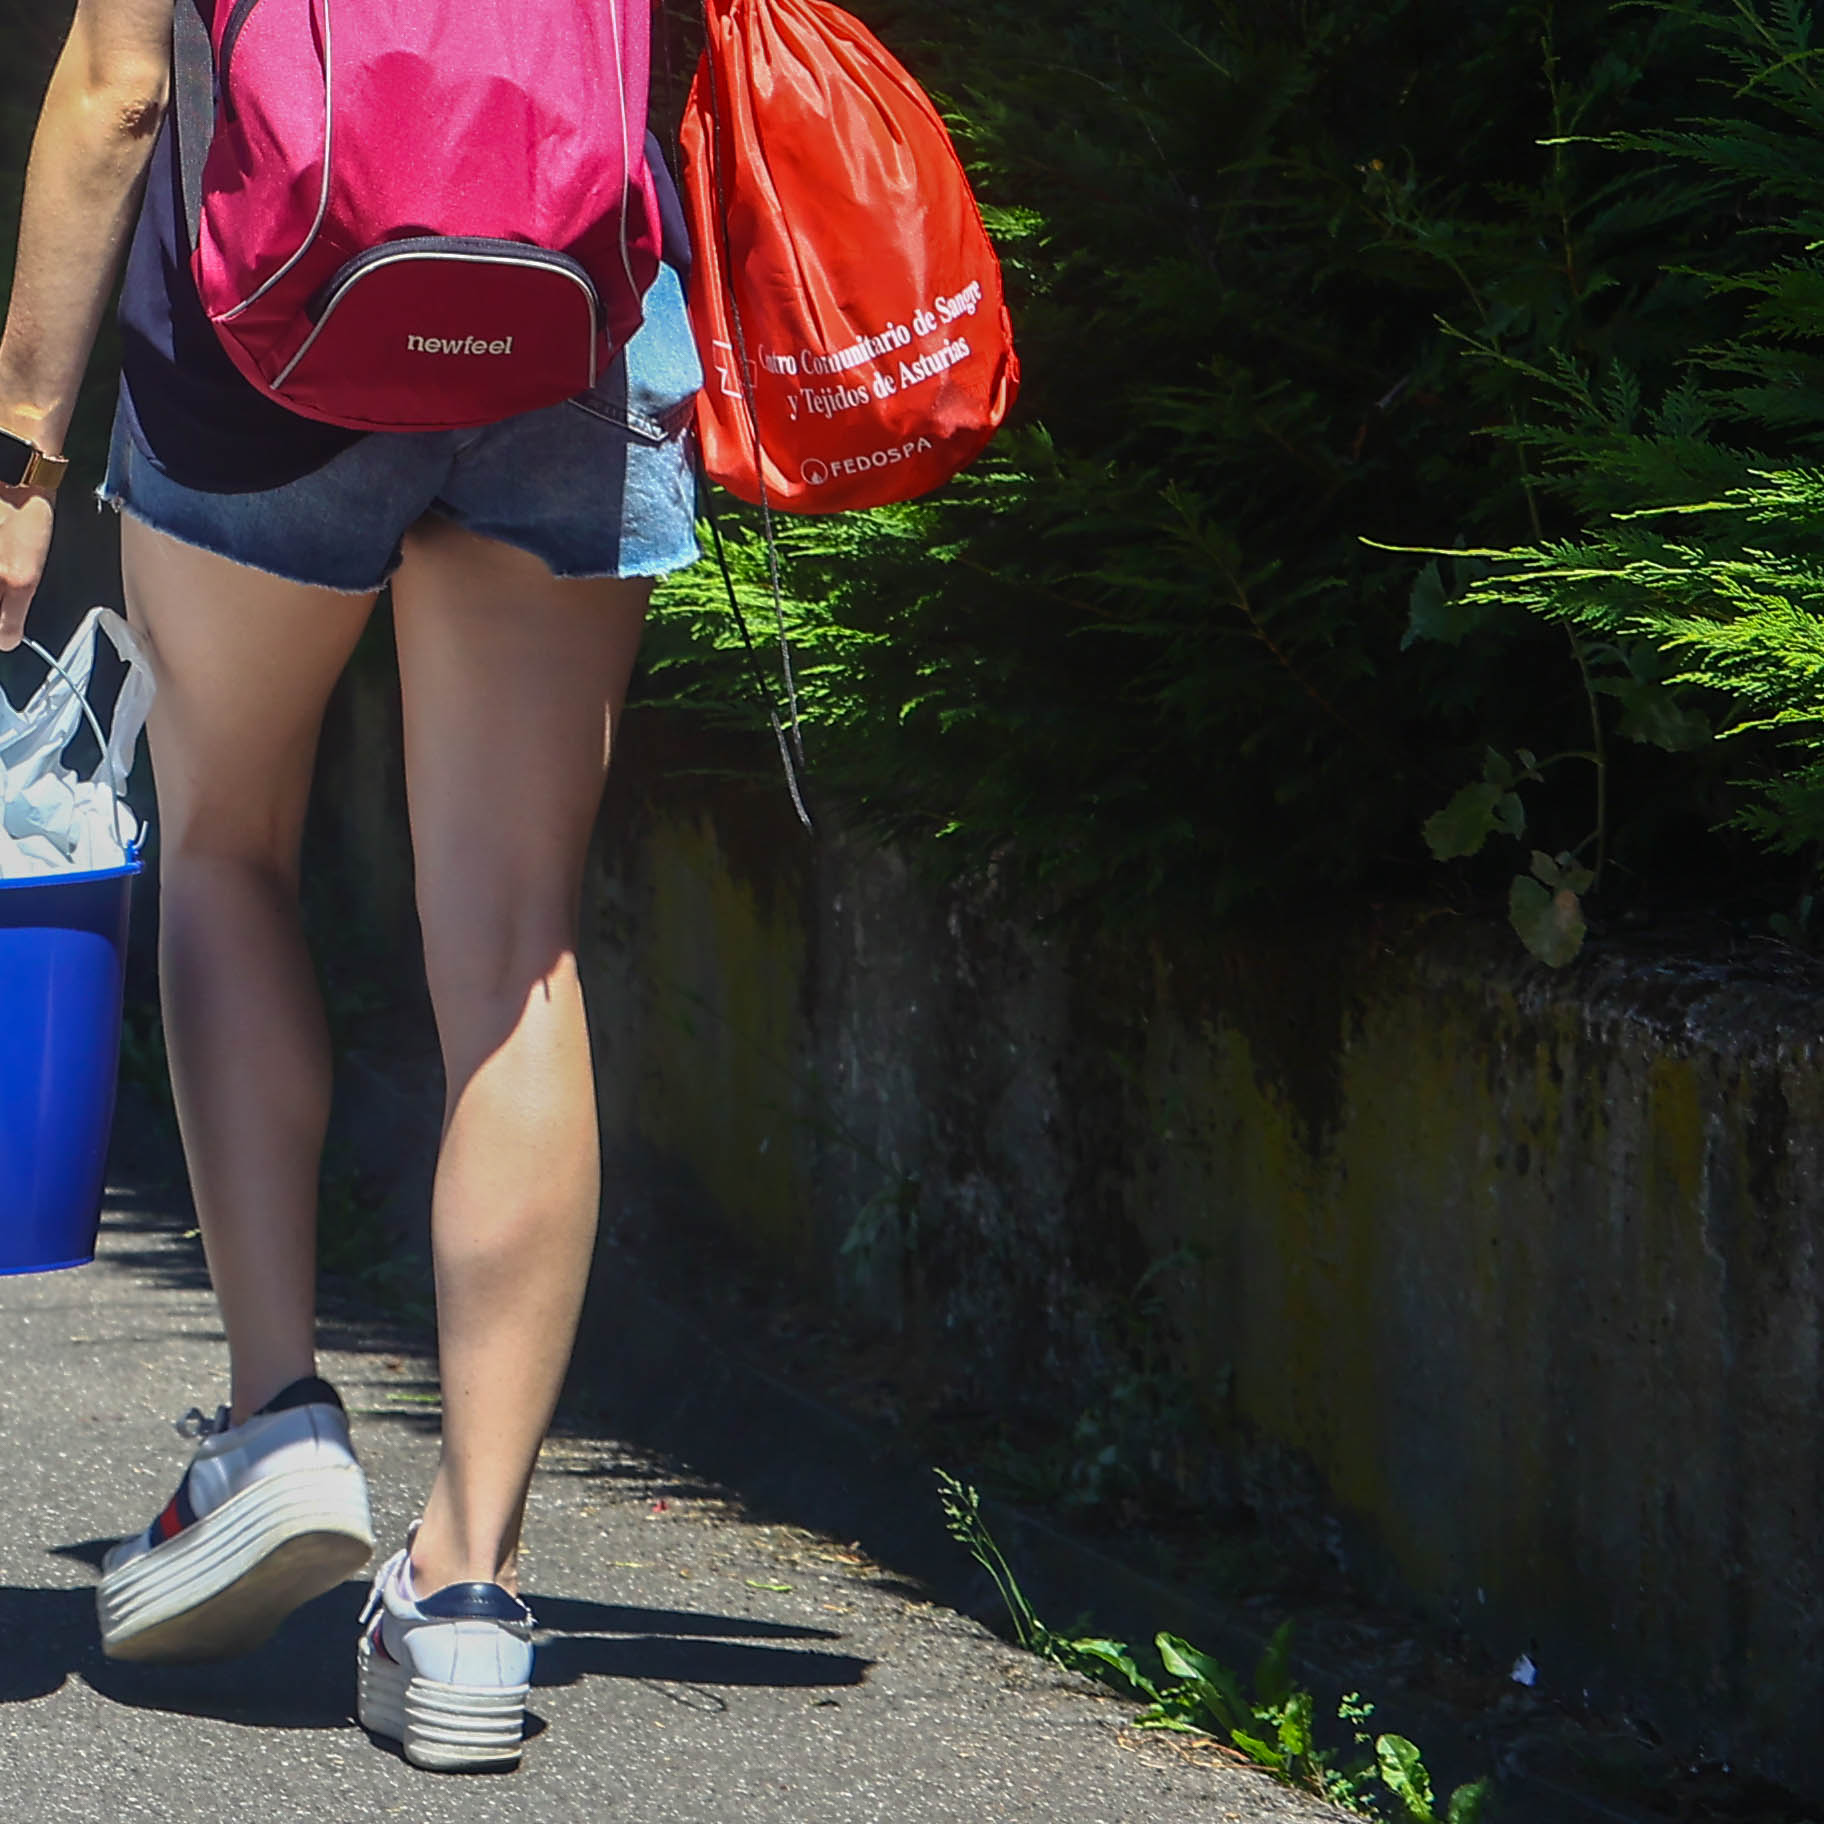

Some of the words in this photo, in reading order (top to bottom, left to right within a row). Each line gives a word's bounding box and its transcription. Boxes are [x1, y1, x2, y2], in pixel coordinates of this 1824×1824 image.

[913, 308, 938, 337] de
[934, 279, 982, 325] Sangre
[406, 333, 514, 356] newfeel
[786, 394, 799, 422] y
[799, 383, 870, 420] Tejidos
[873, 370, 898, 400] de
[898, 336, 971, 390] Asturias
[830, 436, 933, 478] FEDOSPA
